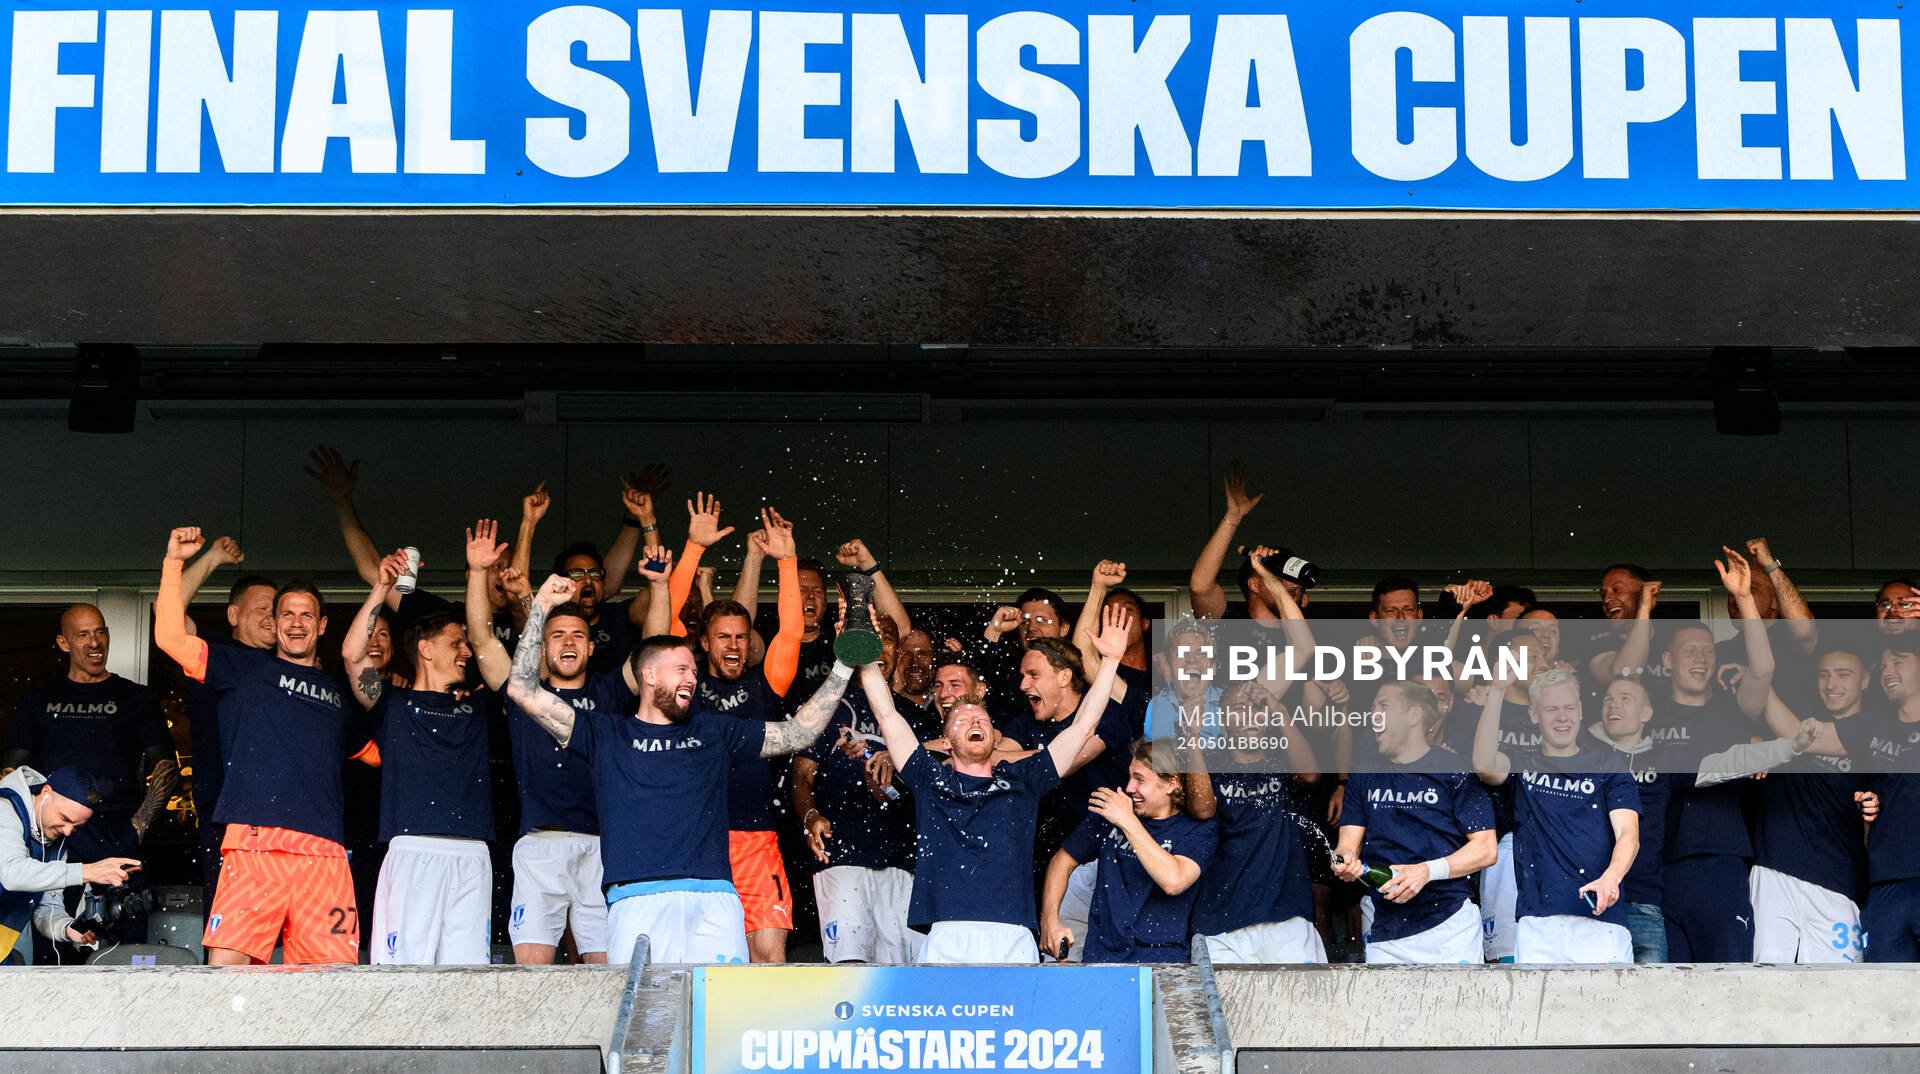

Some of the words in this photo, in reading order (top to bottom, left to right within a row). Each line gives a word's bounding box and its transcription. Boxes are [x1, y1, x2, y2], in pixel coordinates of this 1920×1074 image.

[8, 9, 487, 174] FINAL
[525, 5, 1312, 179] SVENSKA
[1349, 11, 1907, 182] CUPEN
[279, 674, 342, 708] MALMÖ
[46, 701, 118, 714] MALMÖ
[1219, 777, 1282, 799] MALMÖ
[1522, 769, 1595, 794] MALMÖ
[1367, 787, 1439, 804] MALMÖ
[772, 874, 783, 901] 1
[329, 906, 358, 935] 27
[1831, 921, 1864, 952] 33
[861, 1004, 947, 1017] SVENSKA
[951, 1004, 1014, 1017] CUPEN
[741, 1027, 996, 1070] CUPMÄSTARE
[1003, 1028, 1105, 1070] 2024
